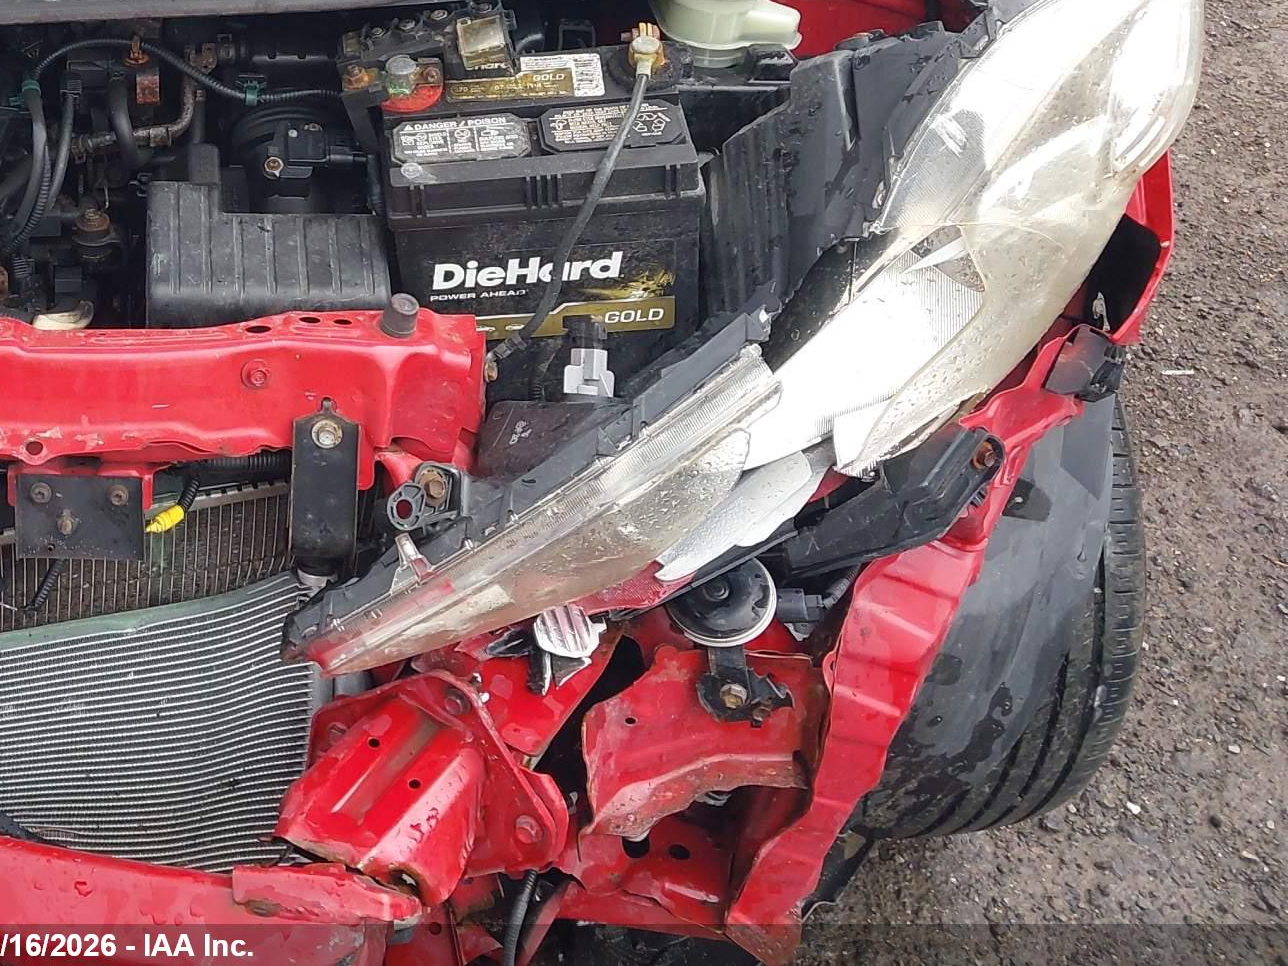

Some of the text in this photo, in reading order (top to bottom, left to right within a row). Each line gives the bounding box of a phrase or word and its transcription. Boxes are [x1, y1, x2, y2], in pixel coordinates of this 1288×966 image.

[533, 74, 565, 82] GOLD
[414, 121, 457, 131] DANGER
[468, 117, 506, 126] POISON
[432, 251, 623, 290] DieHard
[430, 293, 476, 302] POWER
[604, 307, 664, 324] GOLD
